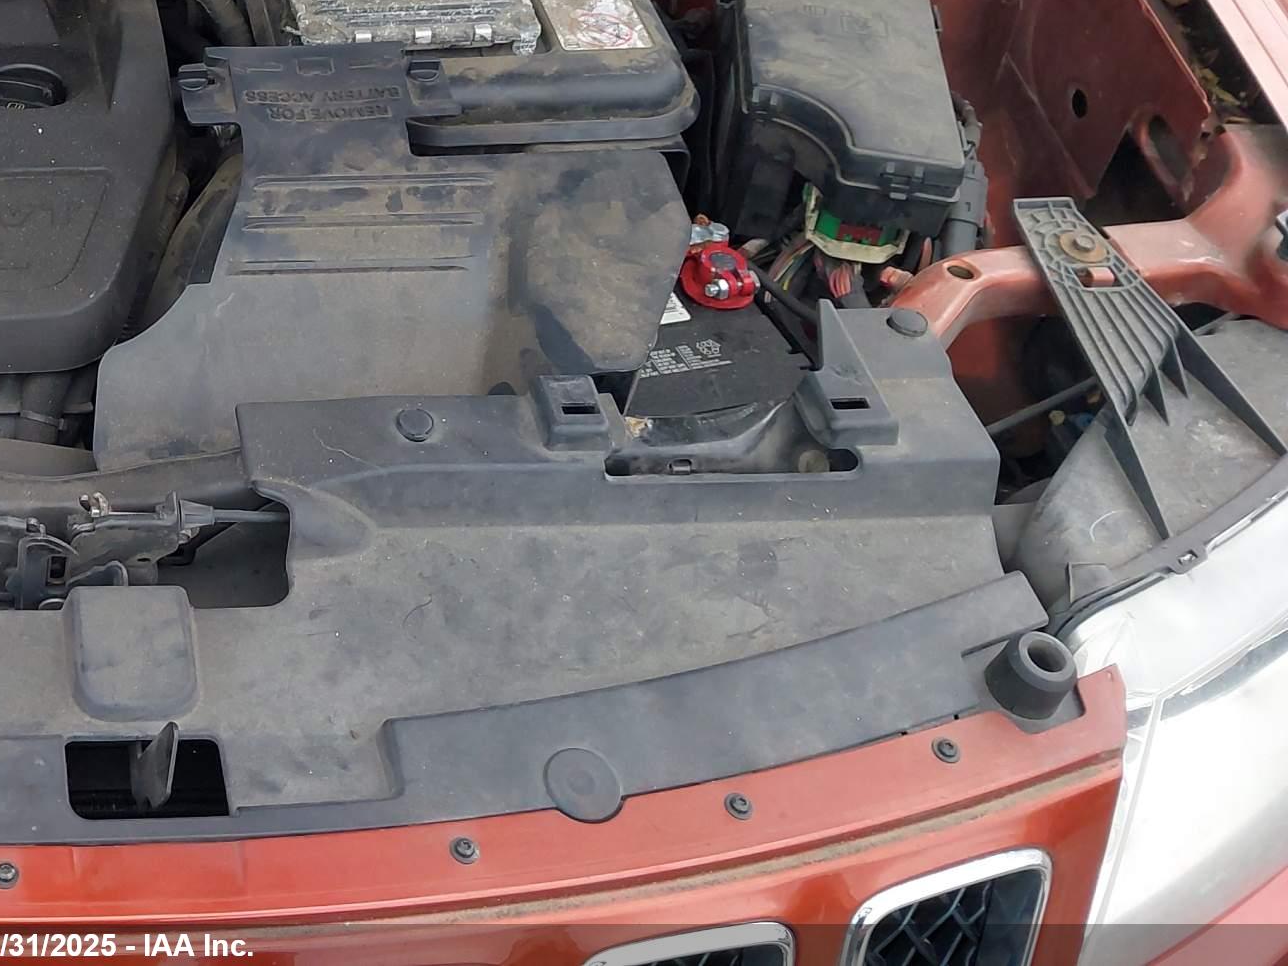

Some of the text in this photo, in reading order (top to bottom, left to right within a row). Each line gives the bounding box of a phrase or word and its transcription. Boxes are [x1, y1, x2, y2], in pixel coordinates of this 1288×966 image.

[244, 89, 314, 104] ACCESS
[268, 104, 391, 122] REMOVE FOR
